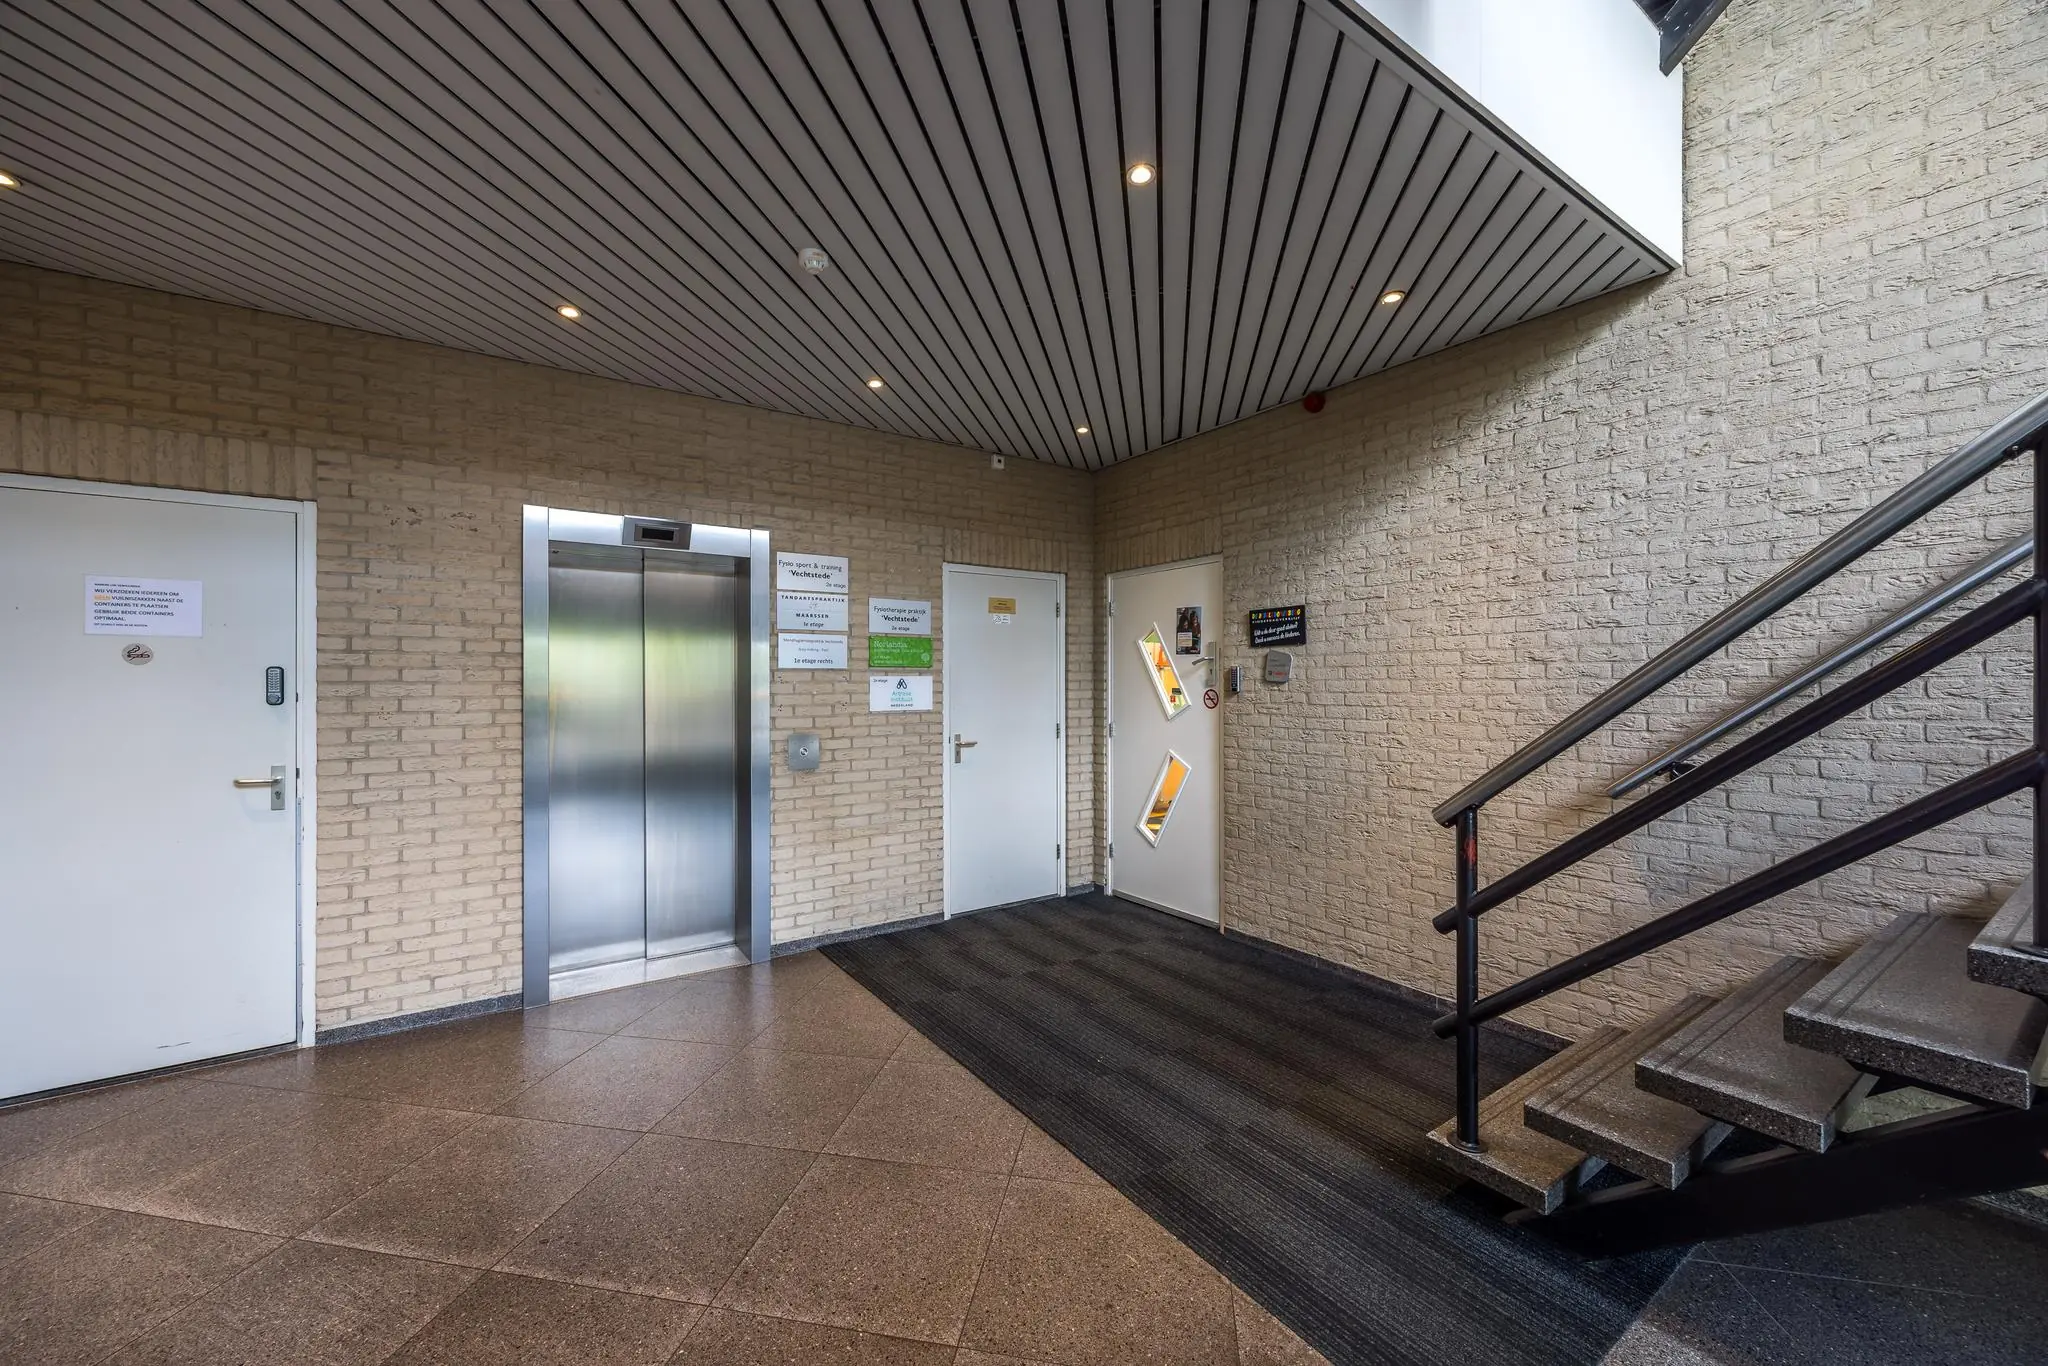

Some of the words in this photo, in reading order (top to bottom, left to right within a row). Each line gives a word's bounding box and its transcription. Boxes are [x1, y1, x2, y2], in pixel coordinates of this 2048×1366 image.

[821, 564, 842, 572] training
[781, 595, 845, 603] TANDARTSPRAKTIJK
[873, 605, 907, 614] Fysiotherapie
